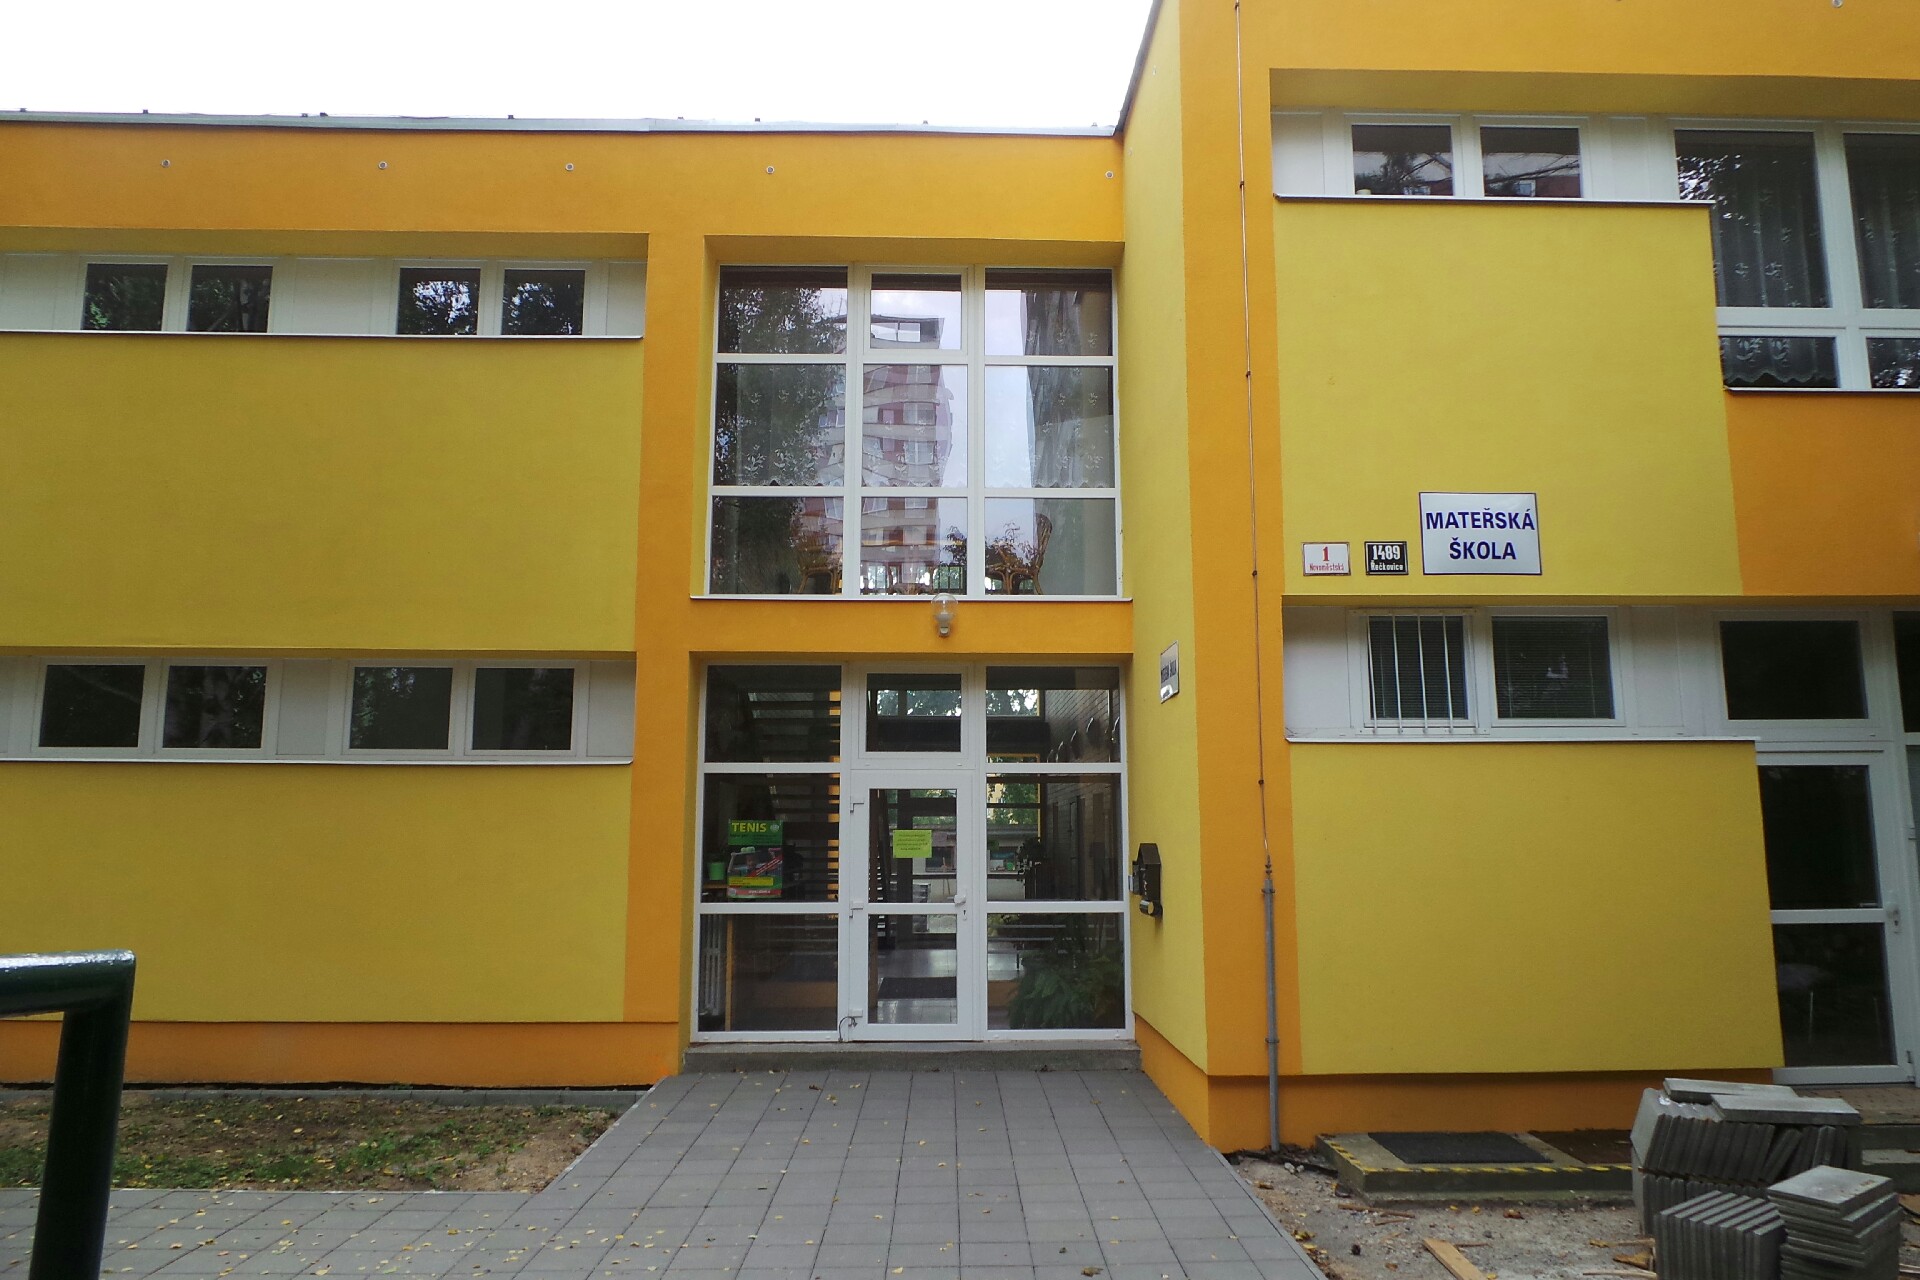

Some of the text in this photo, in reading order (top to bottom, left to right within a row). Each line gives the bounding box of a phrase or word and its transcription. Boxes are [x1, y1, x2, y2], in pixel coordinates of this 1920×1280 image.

[1426, 508, 1535, 530] MATEŘSKÁ
[1323, 546, 1329, 561] 1
[1372, 545, 1400, 560] 1489
[1449, 537, 1516, 560] ŠKOLA
[1370, 560, 1404, 571] Řečkovice
[731, 822, 767, 833] TENIS
